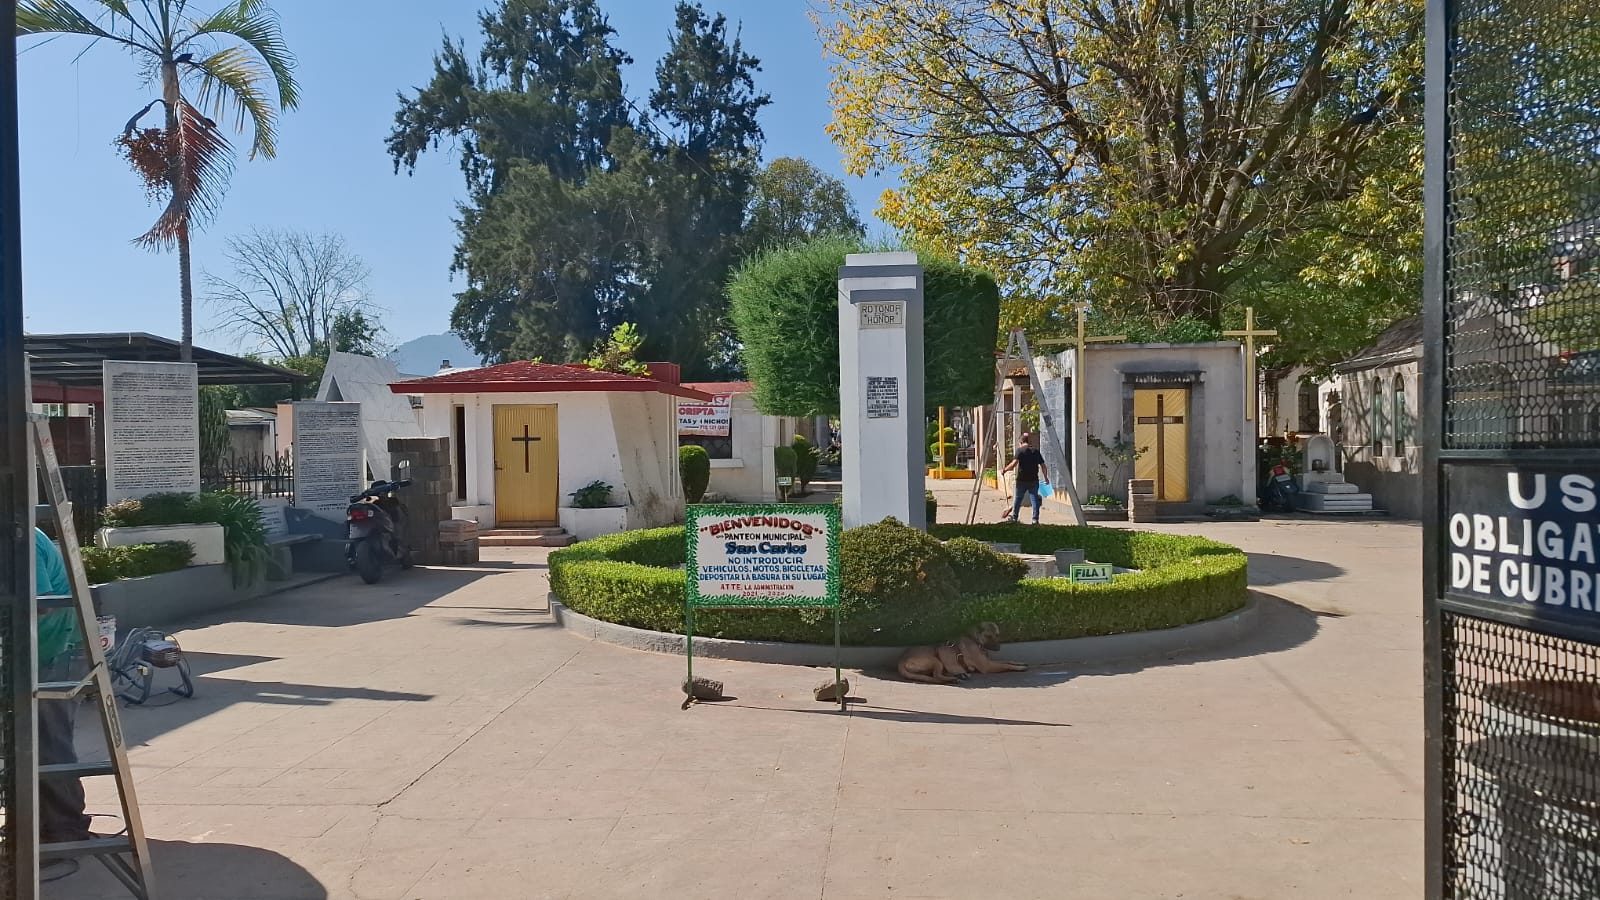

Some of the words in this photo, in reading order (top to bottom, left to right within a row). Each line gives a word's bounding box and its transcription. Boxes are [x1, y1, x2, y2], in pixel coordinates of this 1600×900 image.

[867, 316, 895, 324] HONOR
[679, 408, 715, 416] CRIPTA
[724, 533, 760, 541] PANTEON
[762, 533, 805, 541] MUNICIPAL
[1449, 513, 1600, 564] OBLIGA
[725, 542, 757, 554] San
[758, 542, 807, 554] Carlos
[728, 557, 741, 565] NO
[743, 557, 803, 565] INTRODUCIR
[699, 573, 740, 581] DEPOSITAR
[741, 573, 750, 581] LA
[752, 573, 780, 581] BASURA
[782, 573, 791, 581] EN
[792, 573, 801, 581] SU
[802, 573, 827, 581] LUGAR
[1075, 568, 1099, 578] FILA
[1102, 568, 1105, 576] 1
[1451, 552, 1491, 594] DE
[744, 583, 752, 591] LA
